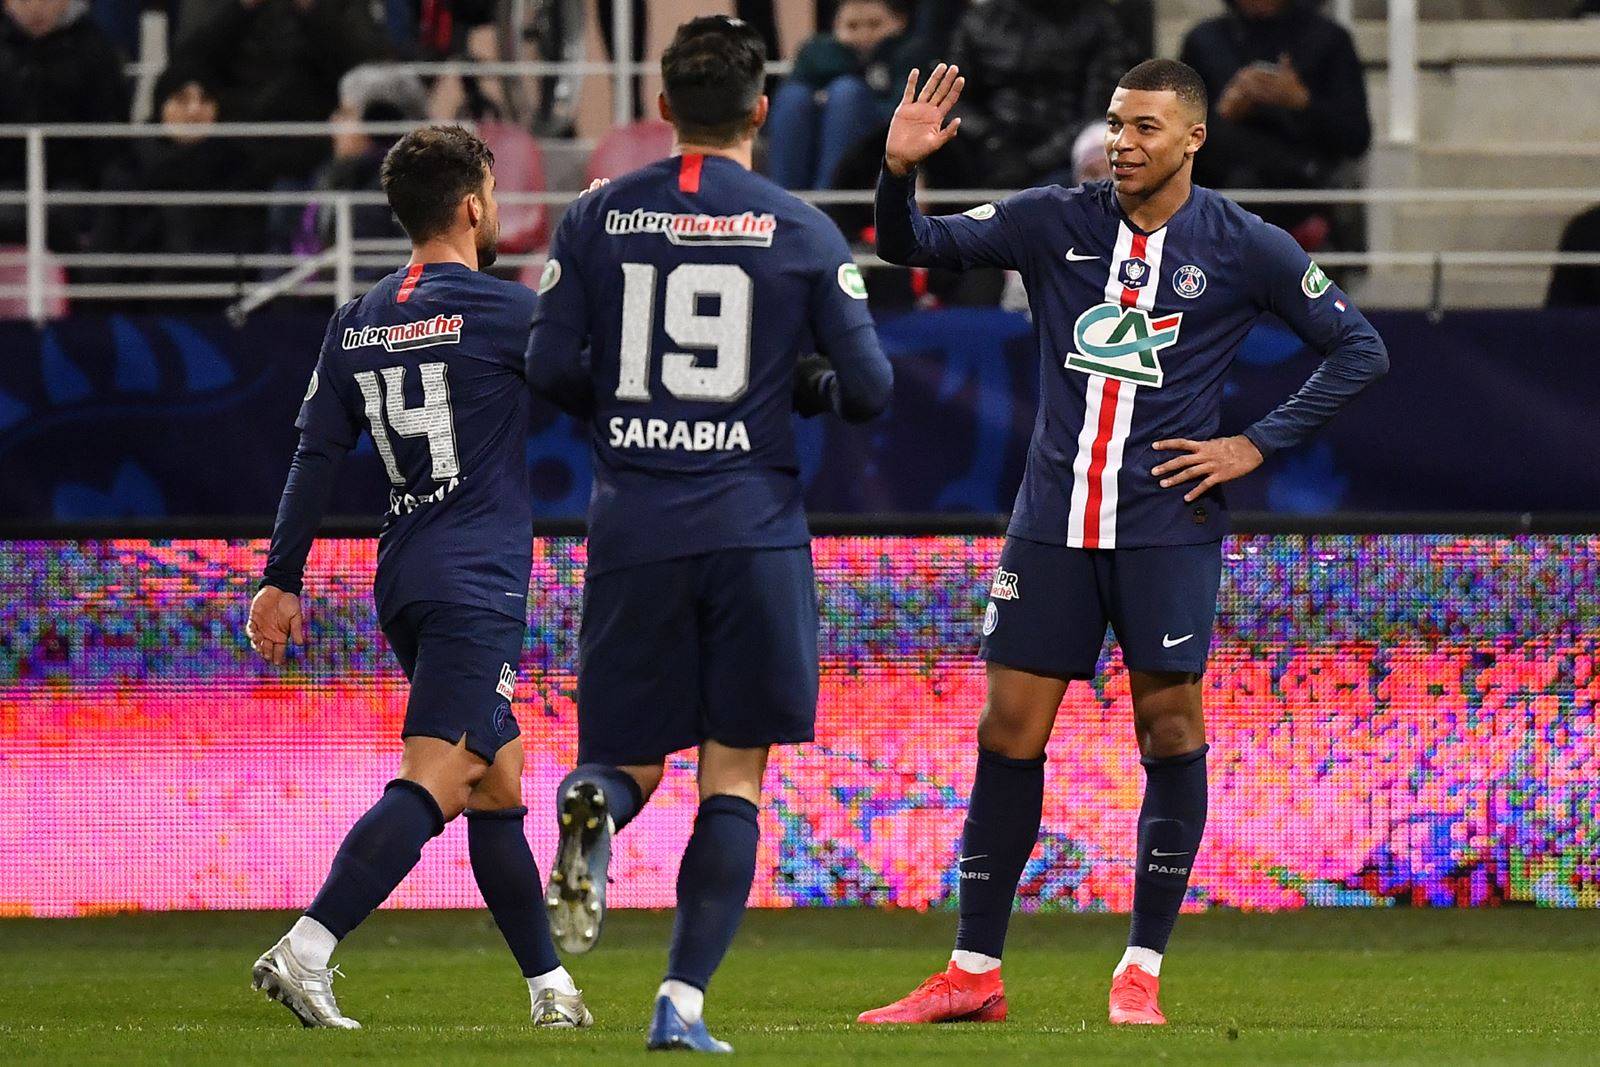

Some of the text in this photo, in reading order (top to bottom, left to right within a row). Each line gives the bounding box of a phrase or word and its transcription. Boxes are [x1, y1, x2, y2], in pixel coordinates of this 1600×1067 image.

[343, 314, 464, 351] Intermarché
[615, 263, 754, 403] 19
[353, 362, 460, 487] 14
[609, 417, 752, 452] SARABIA
[1148, 863, 1188, 876] PARIS
